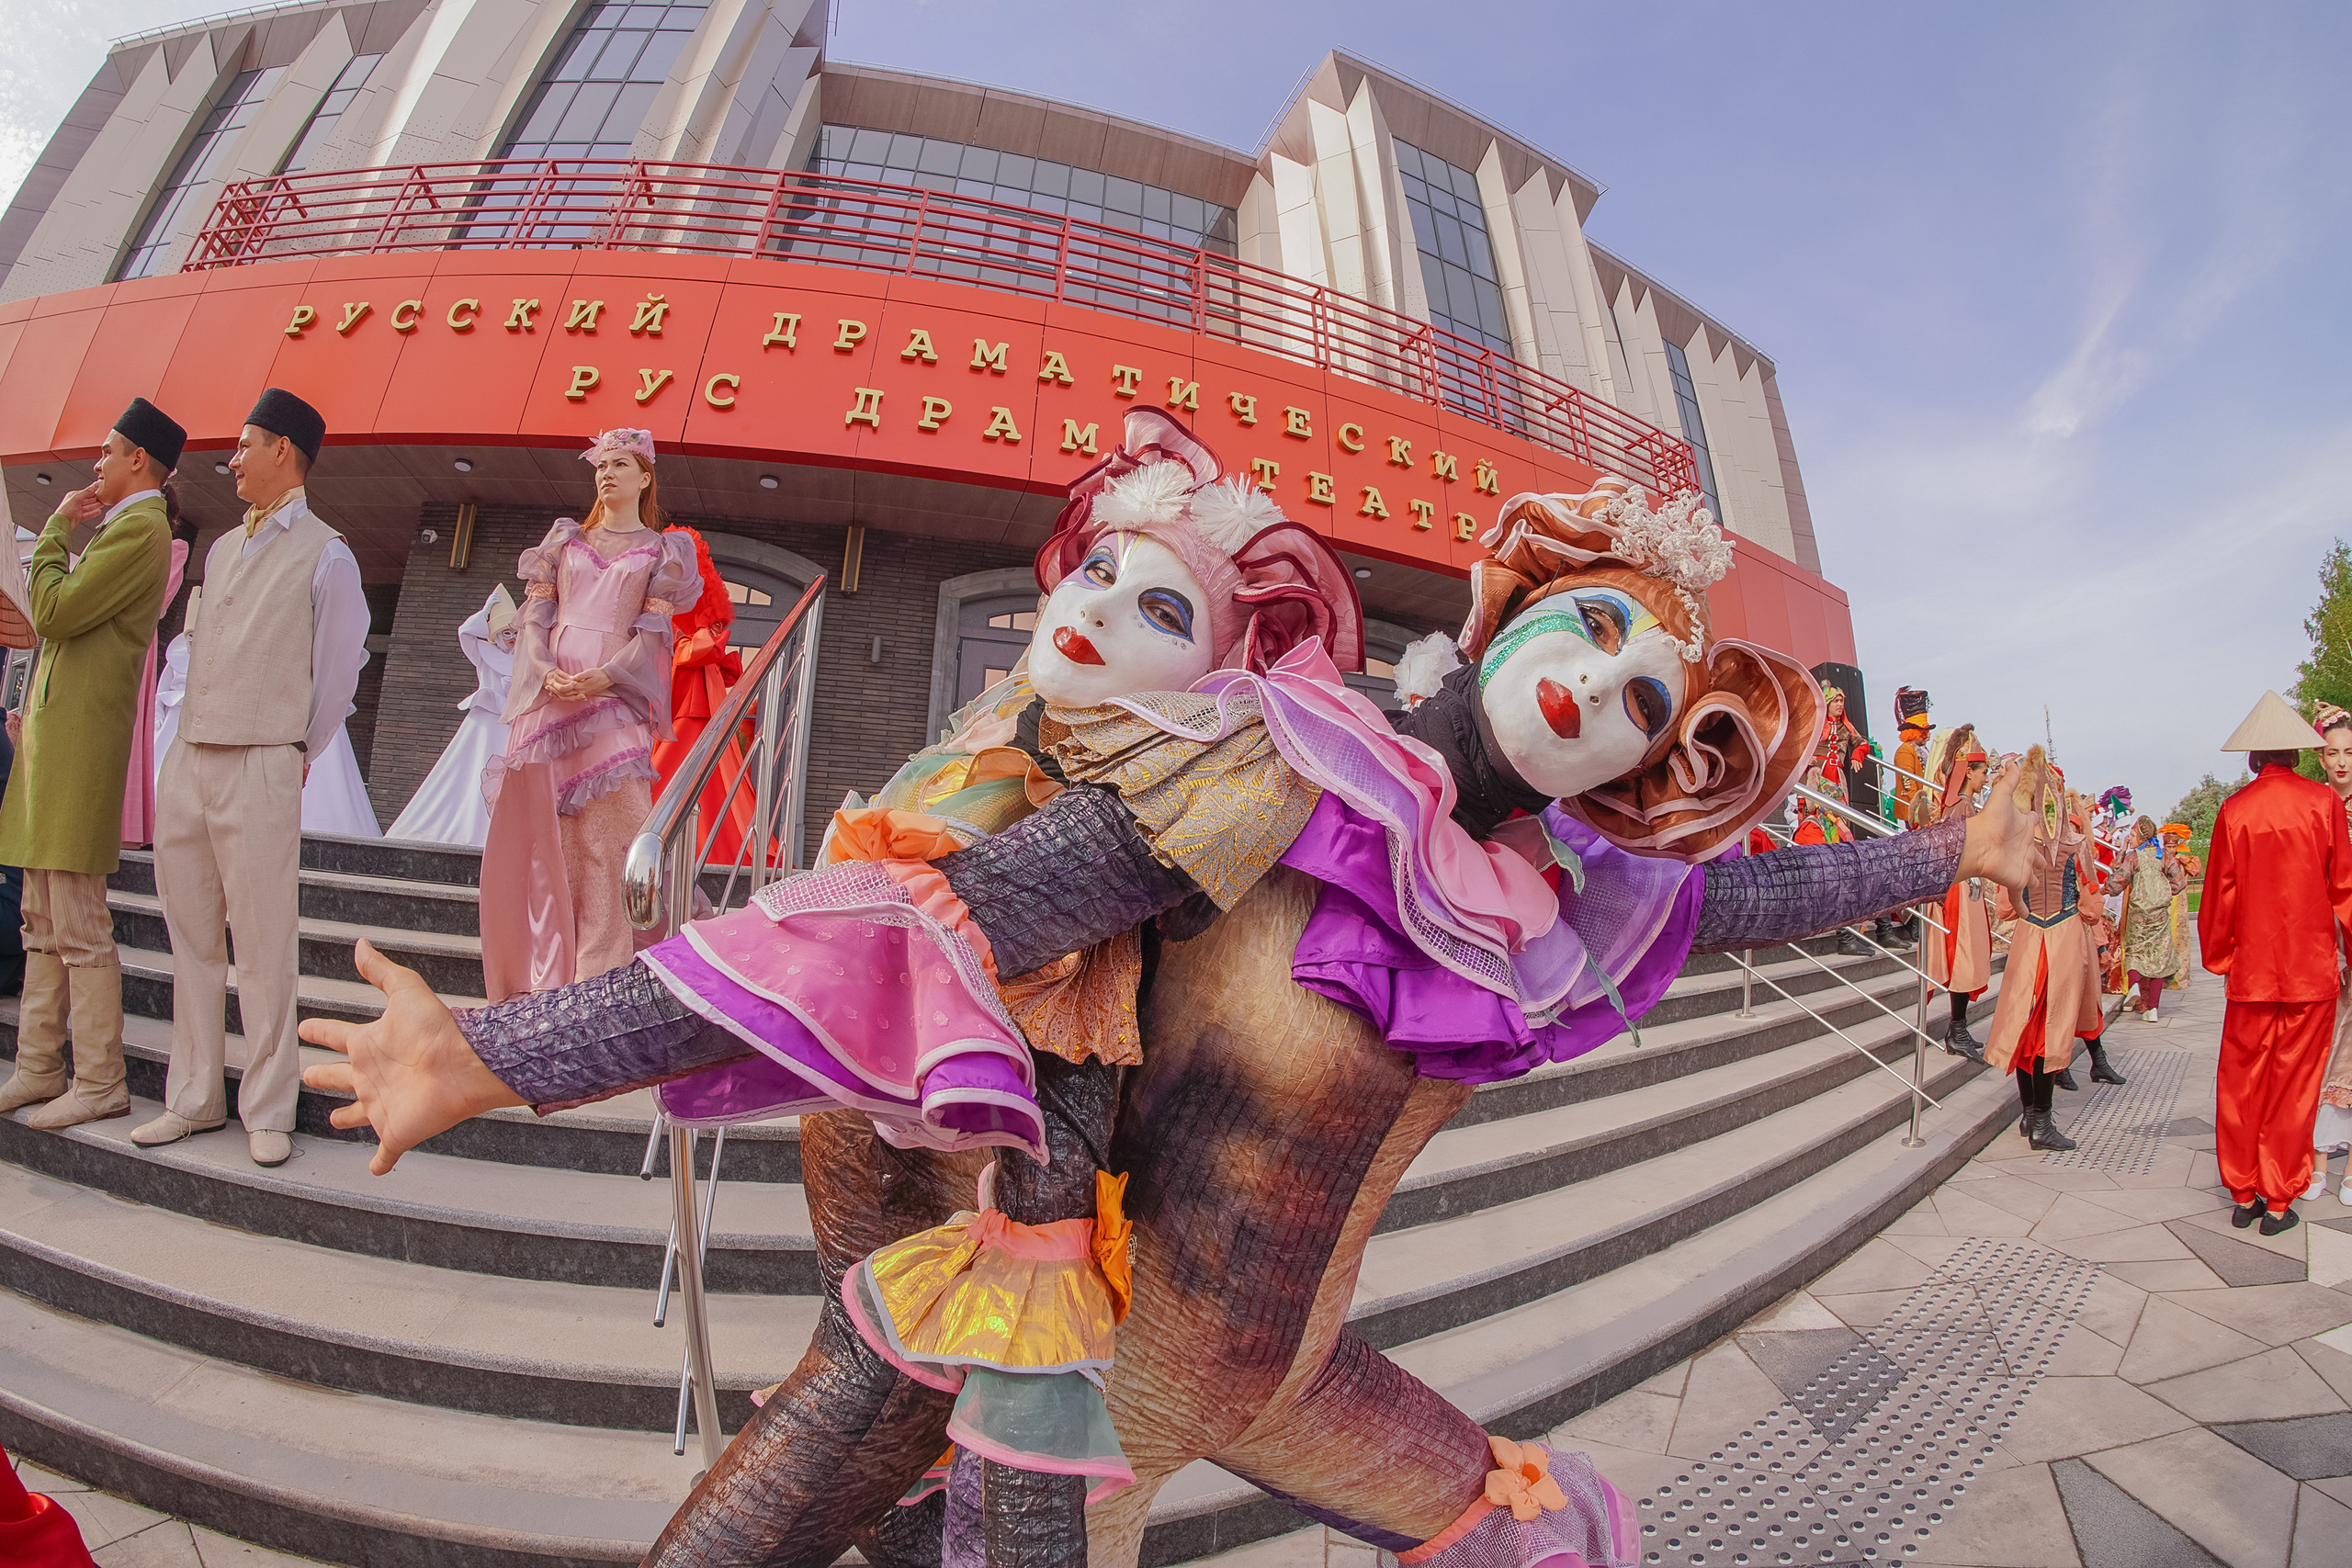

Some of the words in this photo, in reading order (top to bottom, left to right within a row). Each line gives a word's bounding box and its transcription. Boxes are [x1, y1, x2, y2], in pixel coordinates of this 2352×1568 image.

[285, 292, 670, 338] РУССКИЙ
[763, 312, 1500, 496] ДРАМАТИЧЕСКИЙ
[565, 365, 741, 407] РУС
[844, 387, 1100, 457] ДРАМ
[1250, 457, 1477, 542] ТЕАТР
